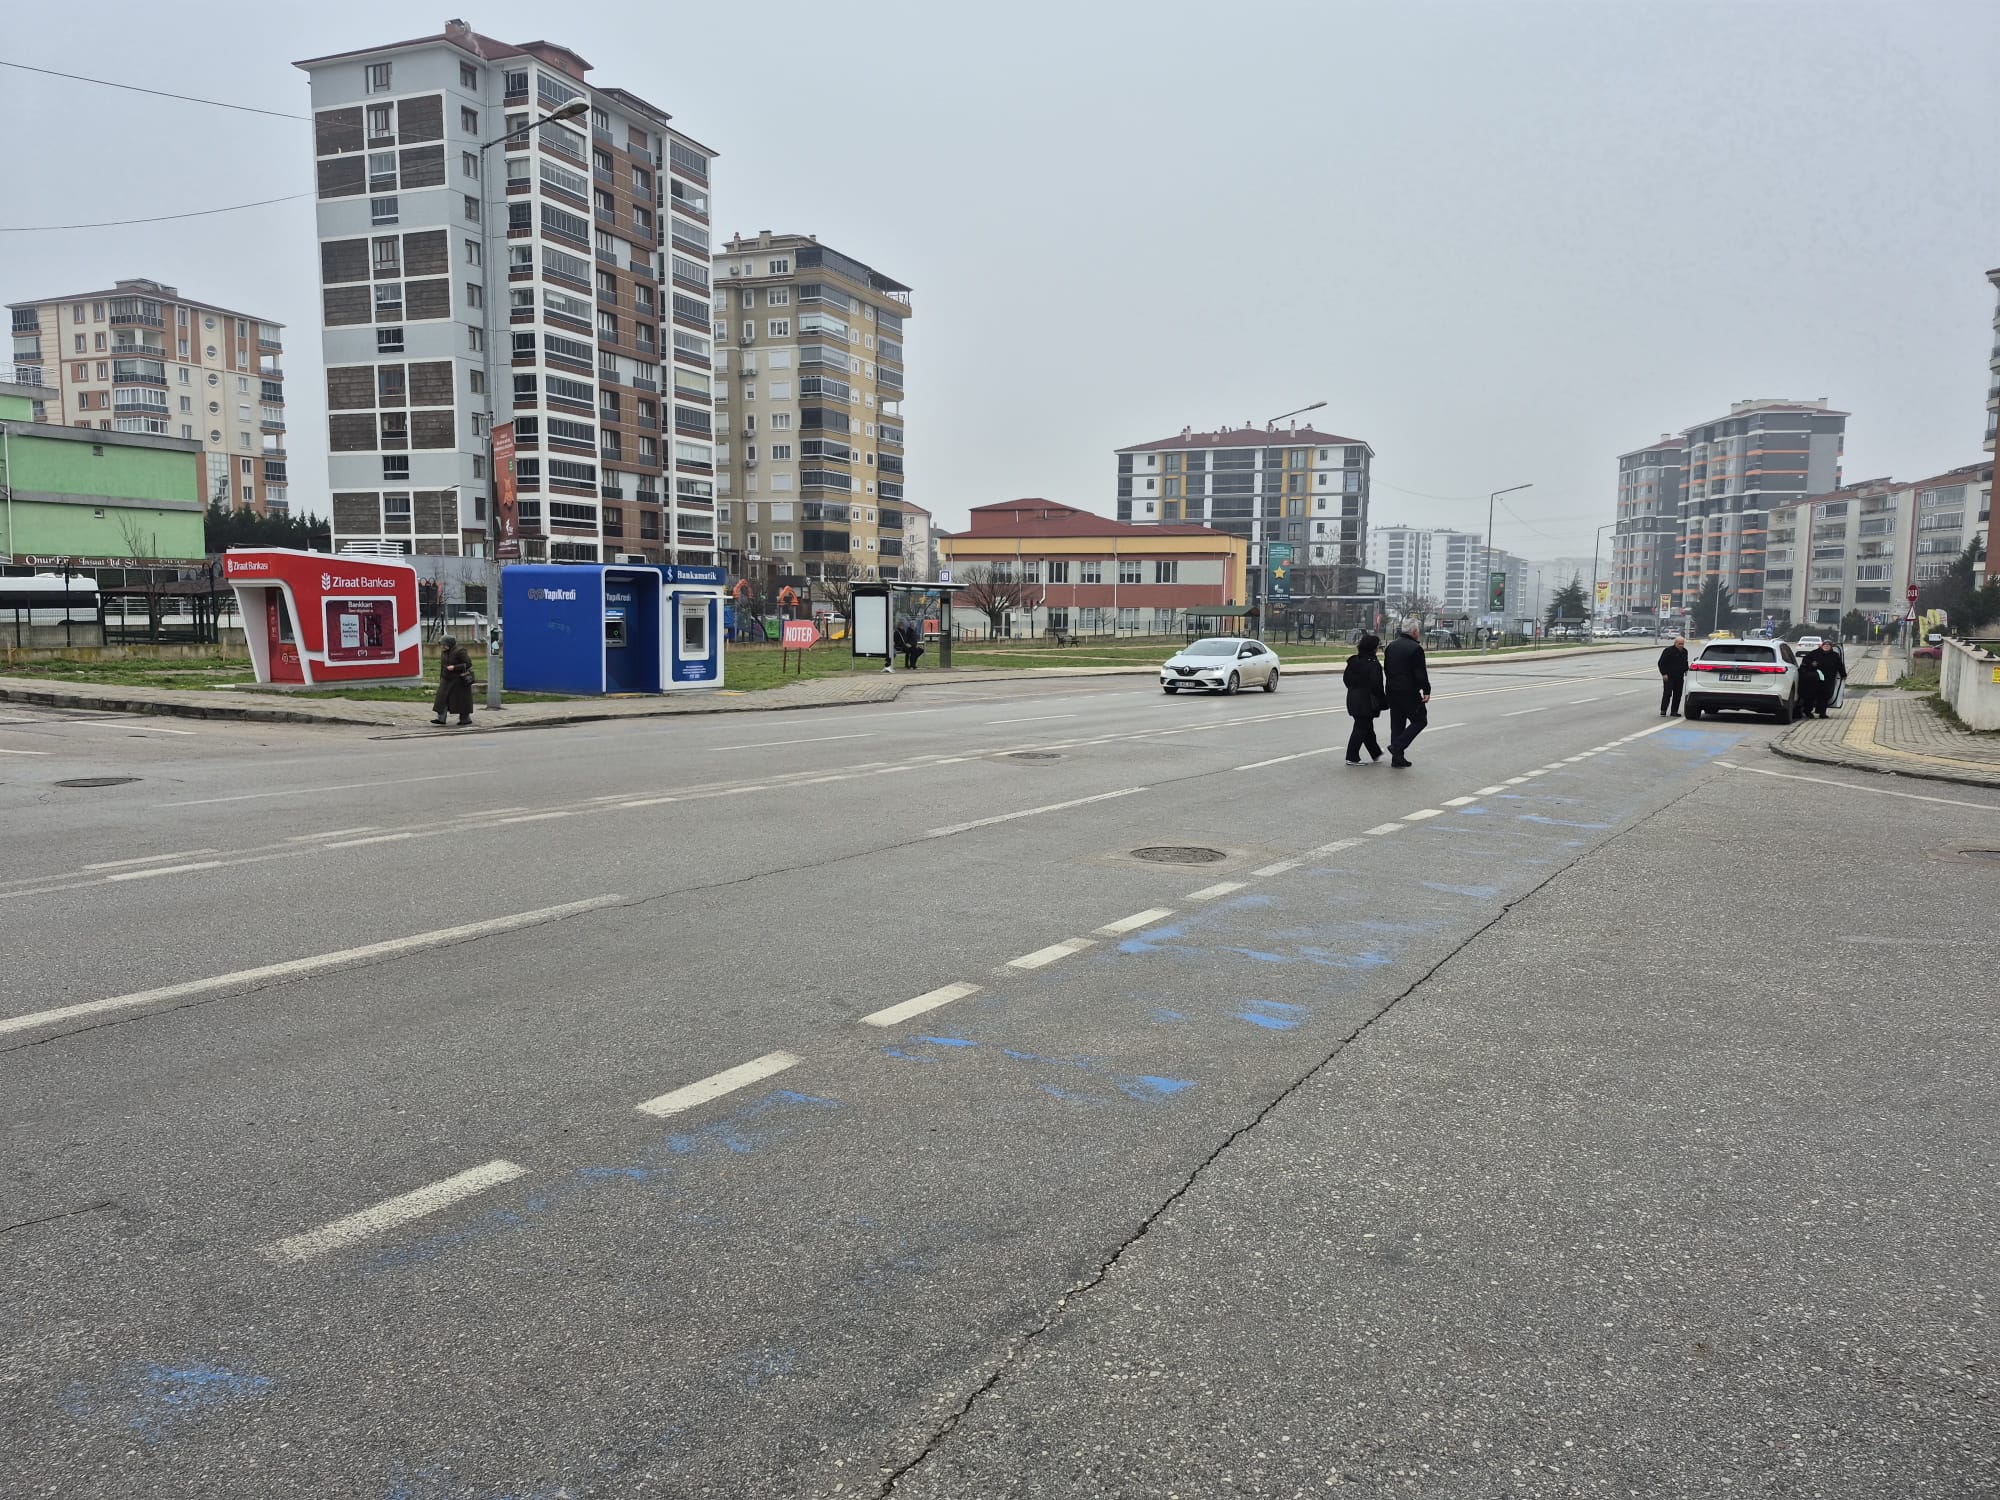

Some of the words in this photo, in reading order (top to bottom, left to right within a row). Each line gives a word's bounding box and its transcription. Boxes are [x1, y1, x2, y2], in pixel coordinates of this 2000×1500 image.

[677, 570, 717, 580] Bankamatik
[333, 577, 360, 588] Ziraat
[361, 577, 396, 588] Bankası
[786, 626, 812, 642] NOTER
